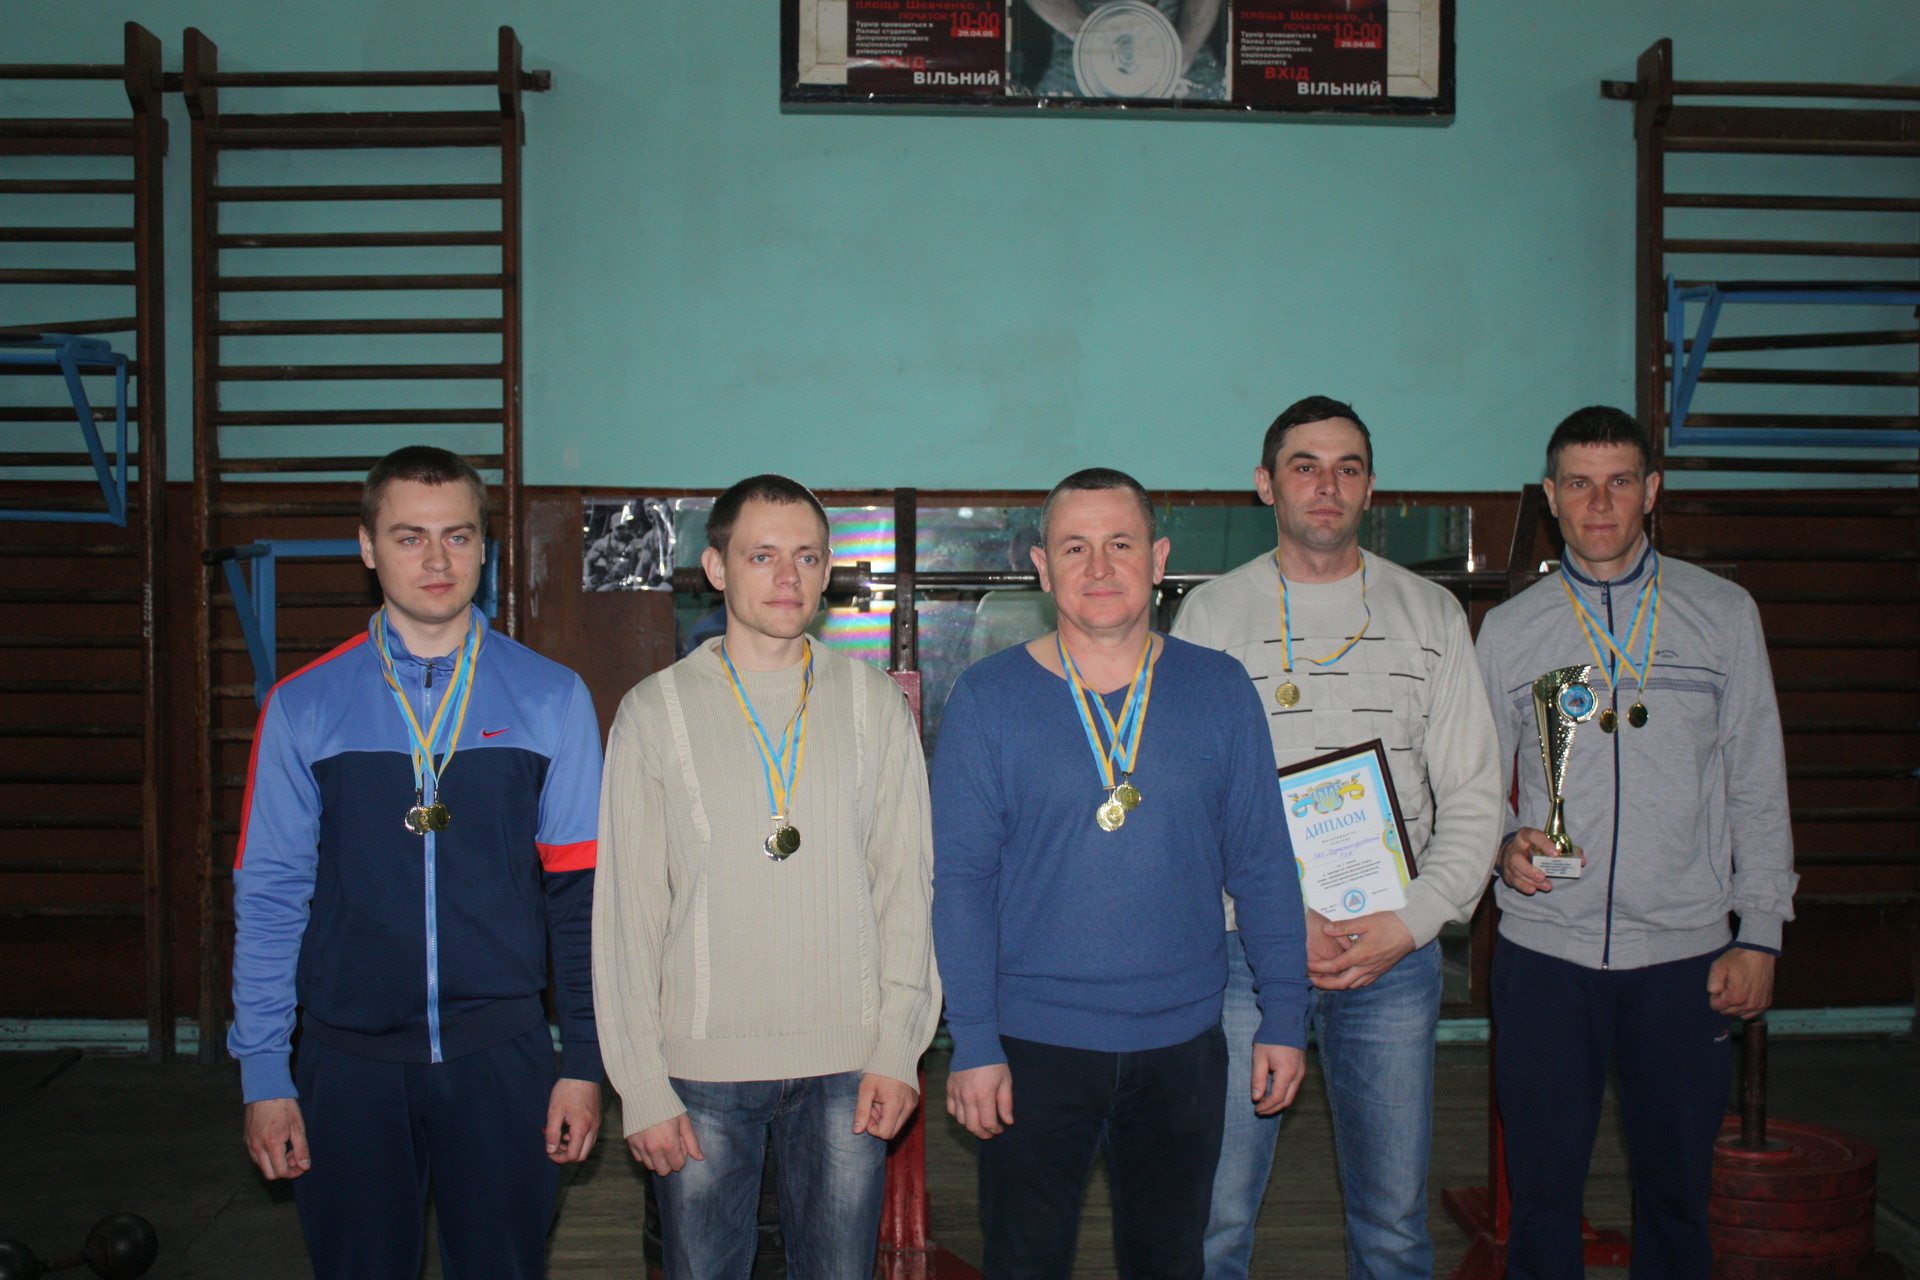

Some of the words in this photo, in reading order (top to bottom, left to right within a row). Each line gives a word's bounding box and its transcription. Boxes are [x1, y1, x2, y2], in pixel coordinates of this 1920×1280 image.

[899, 12, 947, 20] ПОЧАТОК
[951, 11, 1000, 28] 10-00
[1283, 23, 1331, 31] ПОЧАТОК
[1333, 23, 1382, 39] 10-00
[913, 70, 1000, 85] ВІЛЬНИЙ
[1264, 66, 1310, 81] ВХІД
[1297, 81, 1382, 96] ВІЛЬНИЙ
[1305, 809, 1367, 841] ДИПЛОМ
